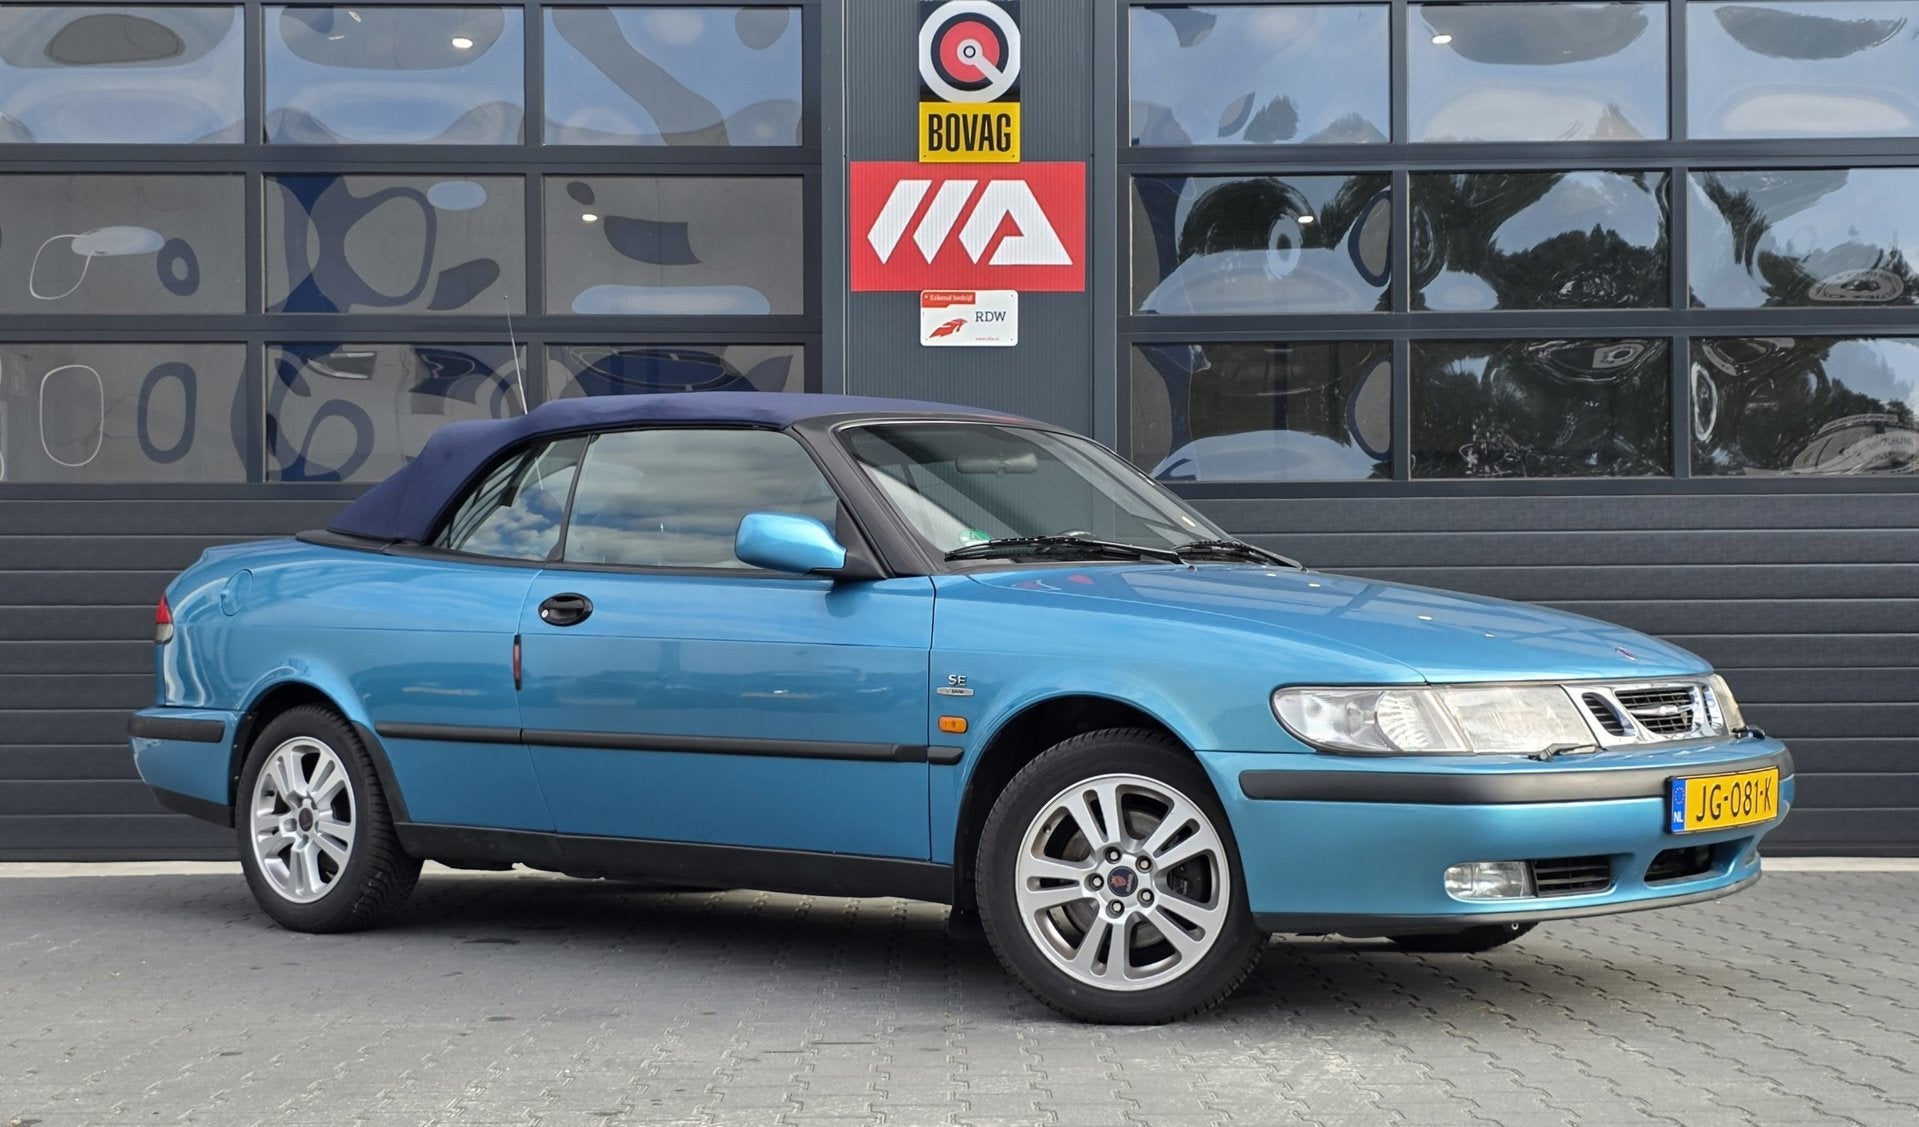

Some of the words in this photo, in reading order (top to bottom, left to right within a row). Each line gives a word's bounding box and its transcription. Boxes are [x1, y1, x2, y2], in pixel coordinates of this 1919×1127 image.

[928, 113, 1011, 152] BOVAG
[975, 311, 1007, 322] RDW
[948, 674, 967, 686] SE
[1696, 776, 1772, 822] JG-081-K
[1673, 811, 1684, 823] NL
